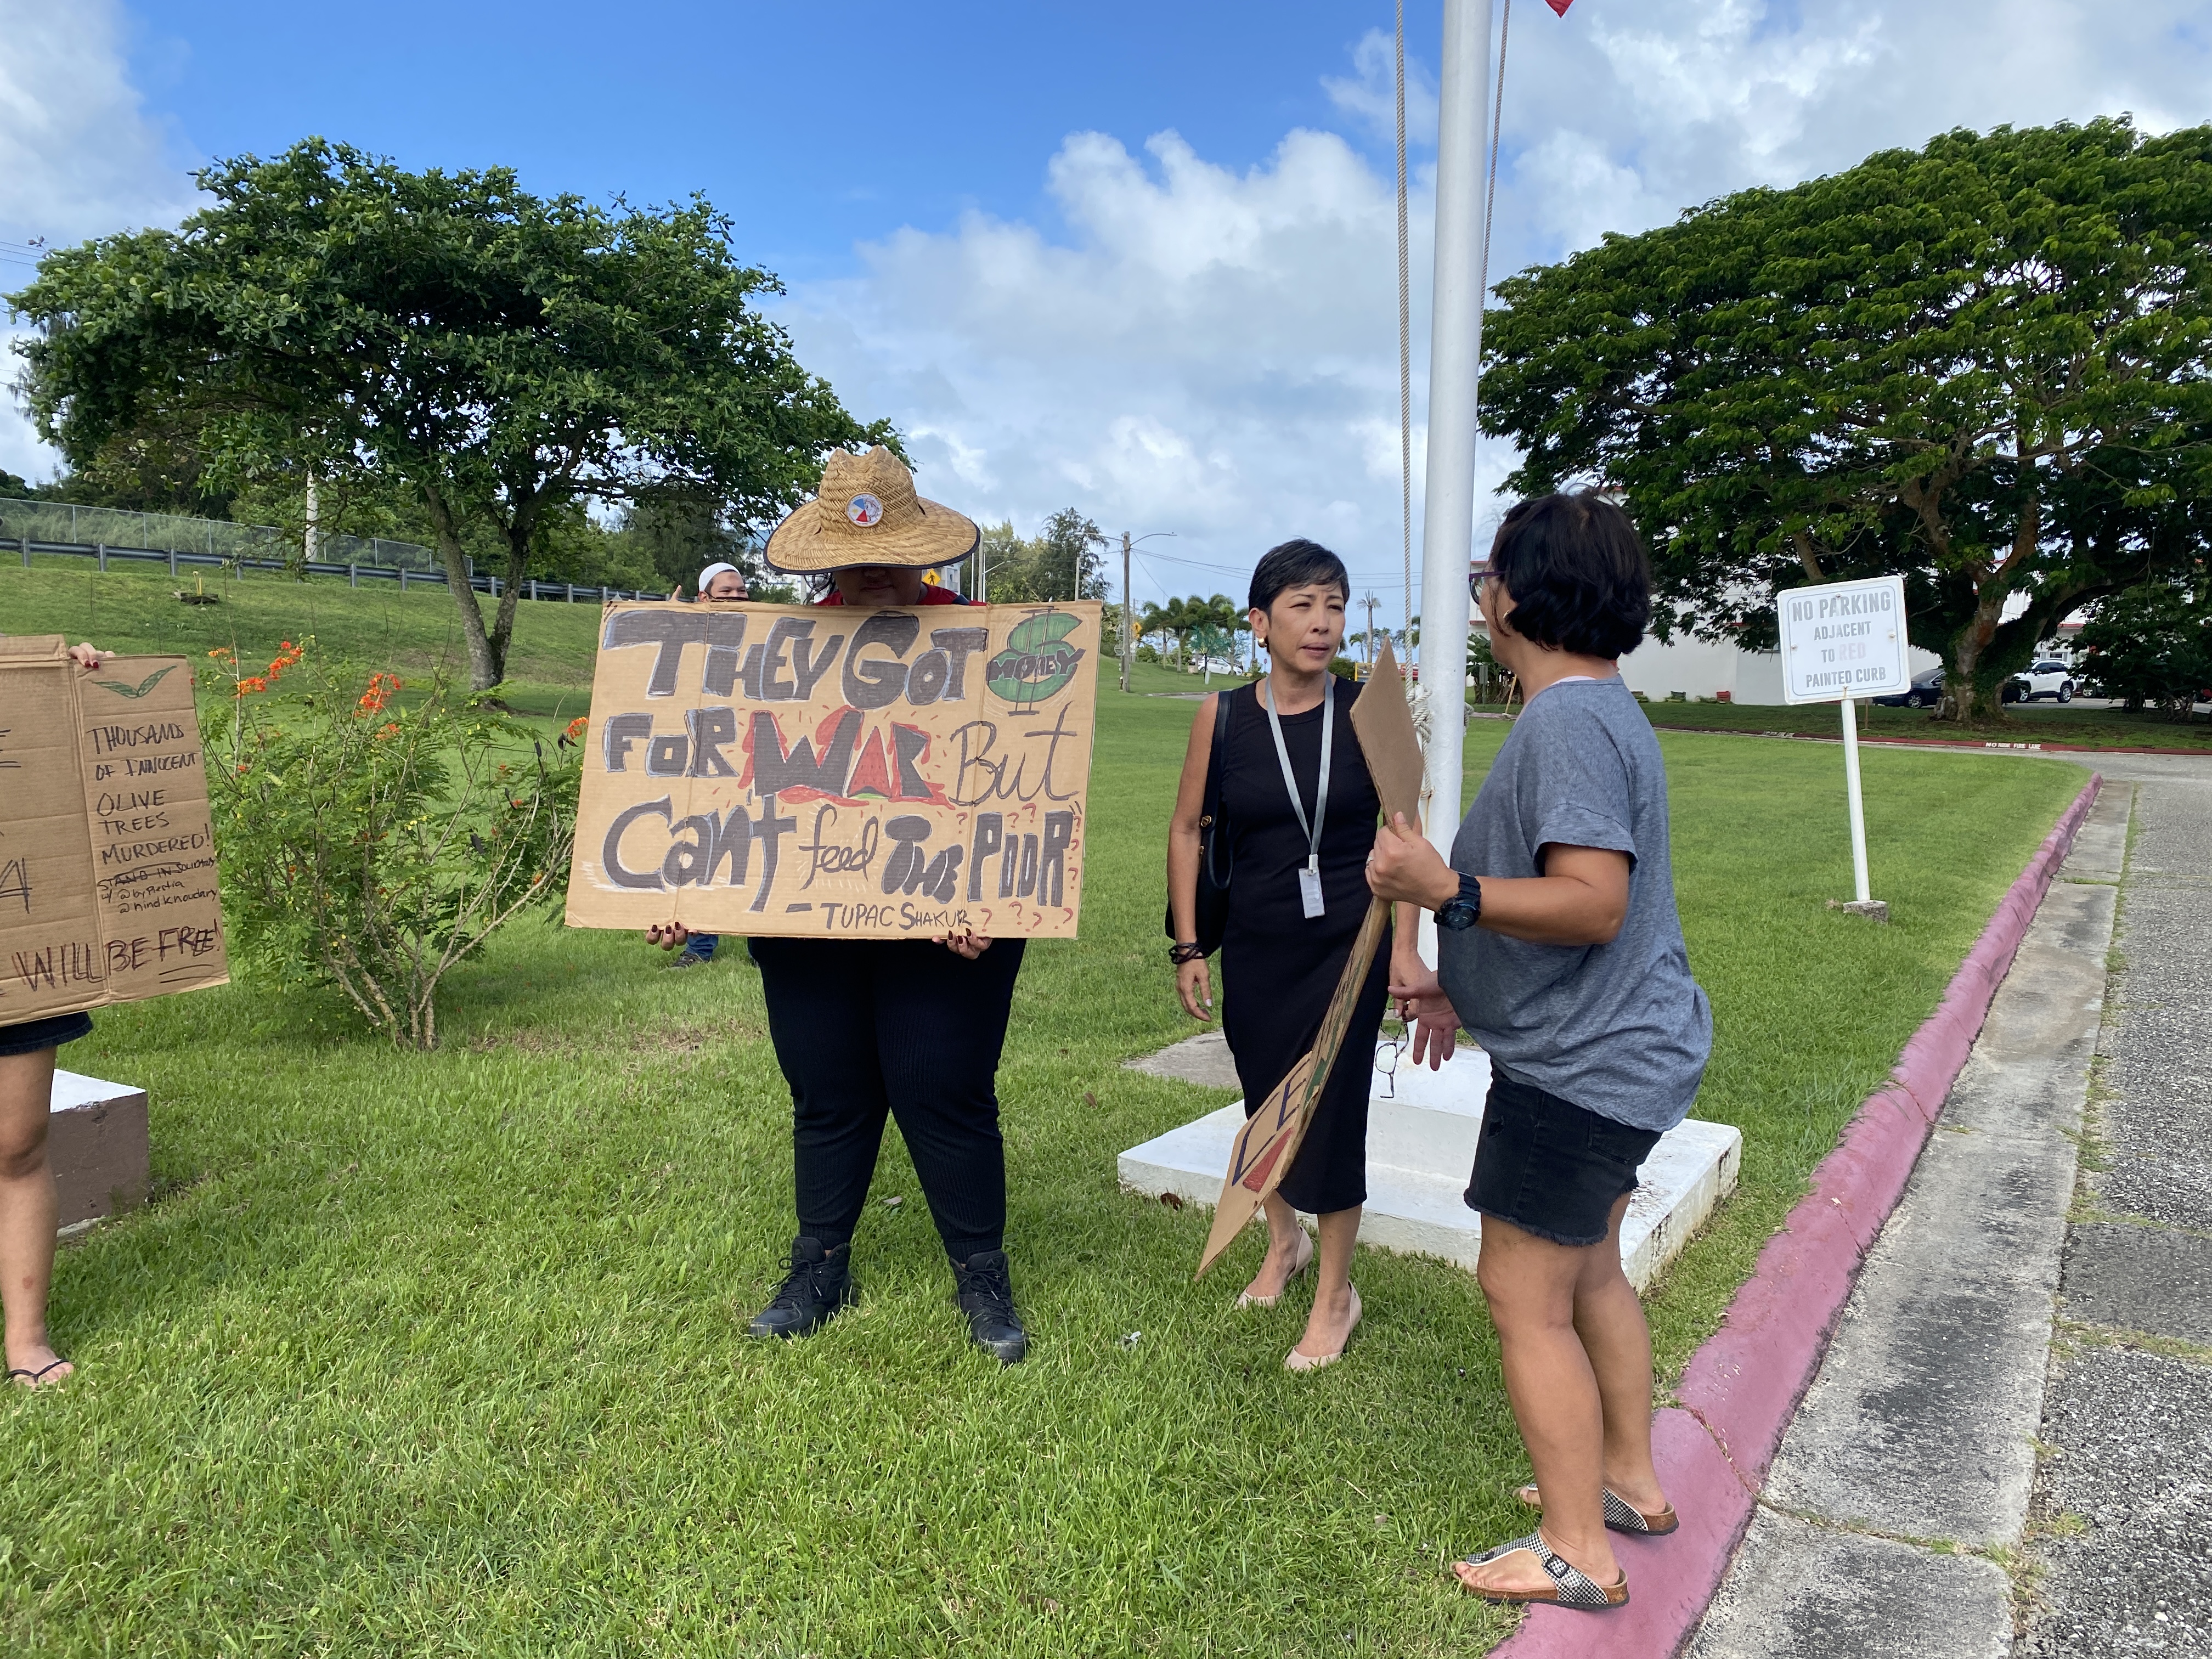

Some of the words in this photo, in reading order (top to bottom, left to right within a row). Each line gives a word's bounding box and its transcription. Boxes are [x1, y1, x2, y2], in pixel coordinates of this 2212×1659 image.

[1793, 601, 1813, 622] NO
[1819, 591, 1891, 619] PARKING
[1814, 621, 1871, 641] ADJACENT
[841, 611, 989, 710] GOT
[987, 648, 1086, 681] MONEY
[1821, 648, 1835, 663] TO
[1838, 642, 1866, 661] RED
[1806, 670, 1852, 687] PAINTED
[1856, 667, 1886, 682] CURB
[86, 723, 184, 754] THOUSANDS
[603, 706, 740, 778] FOR
[753, 709, 935, 800] WAR
[948, 700, 1079, 807] But
[95, 764, 116, 781] OF
[120, 753, 199, 776] INNOCENT
[97, 789, 167, 816] OLIVE
[98, 812, 170, 835] TREES
[102, 823, 210, 865] MURDERED!
[799, 804, 879, 890] feed
[881, 814, 964, 904] THE
[157, 866, 172, 878] IN
[820, 902, 894, 930] TUPAC
[898, 901, 972, 930] SHAKUR
[12, 941, 108, 992] WILL
[104, 936, 153, 976] BE
[153, 918, 221, 962] FREE!
